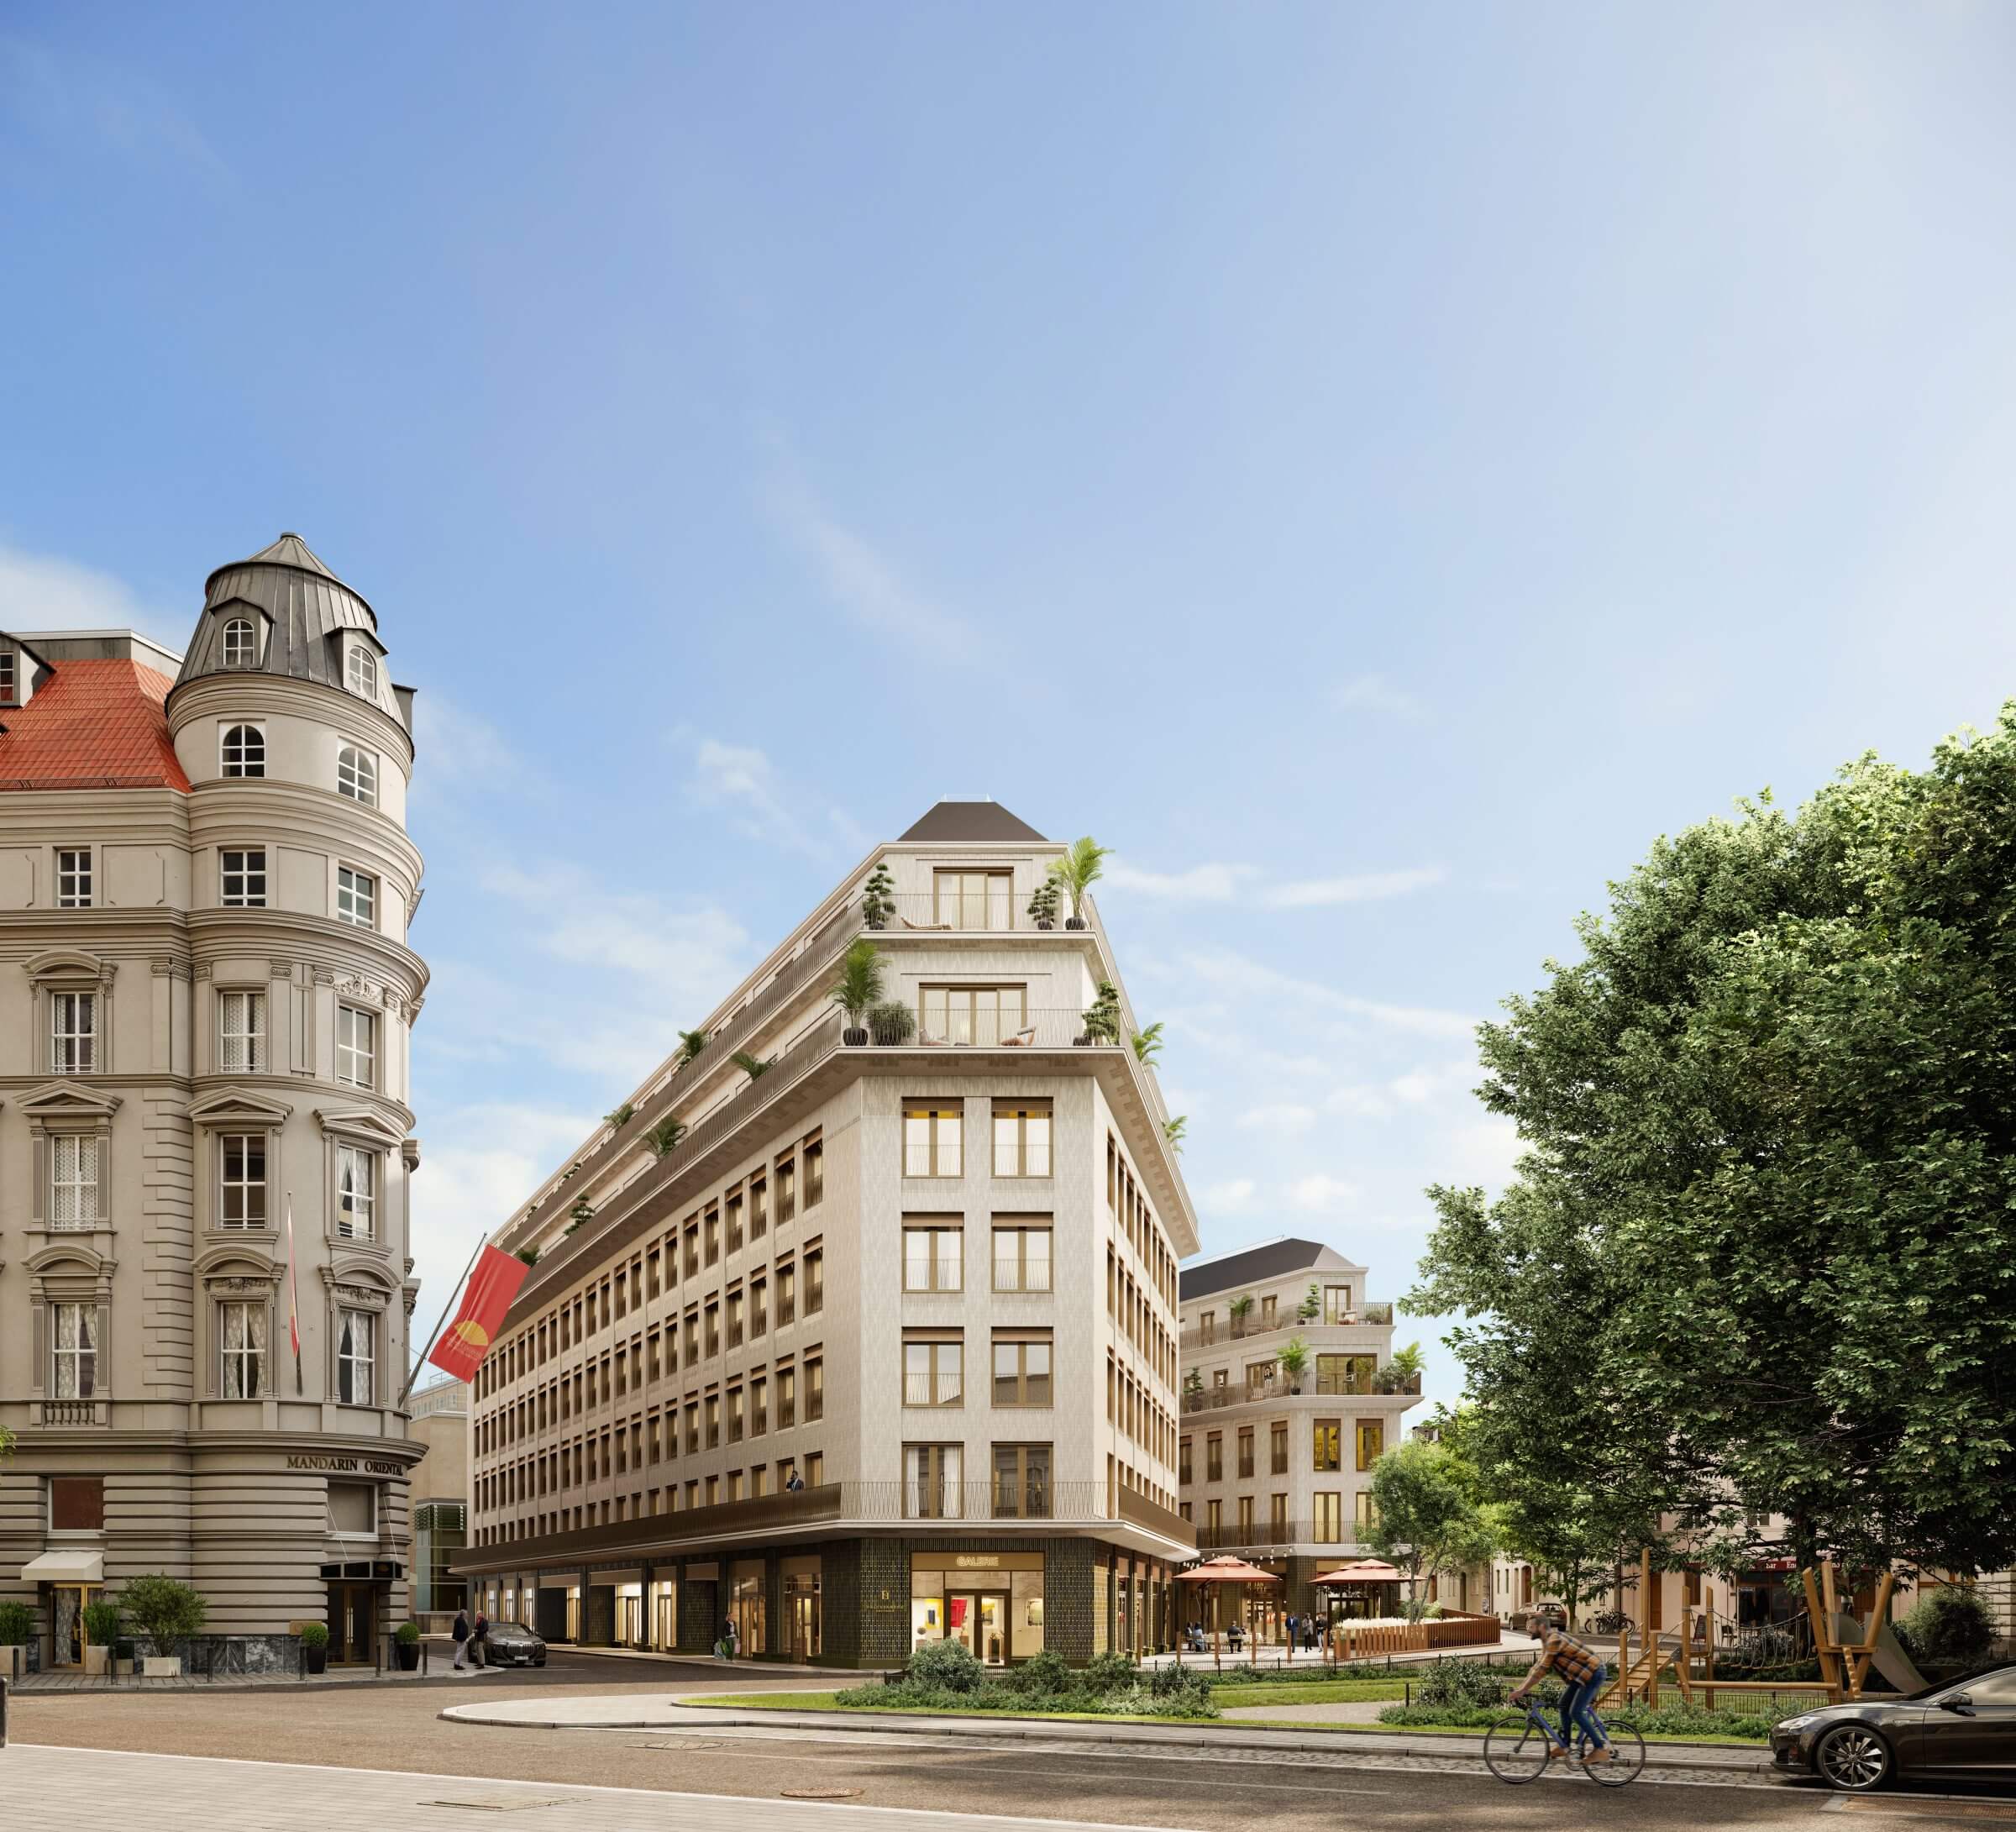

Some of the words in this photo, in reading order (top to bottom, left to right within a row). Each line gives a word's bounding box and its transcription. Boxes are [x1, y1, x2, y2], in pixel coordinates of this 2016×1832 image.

[286, 1456, 358, 1471] MANDARIN
[364, 1460, 403, 1476] ORIENTAL
[957, 1556, 999, 1567] GALERIE
